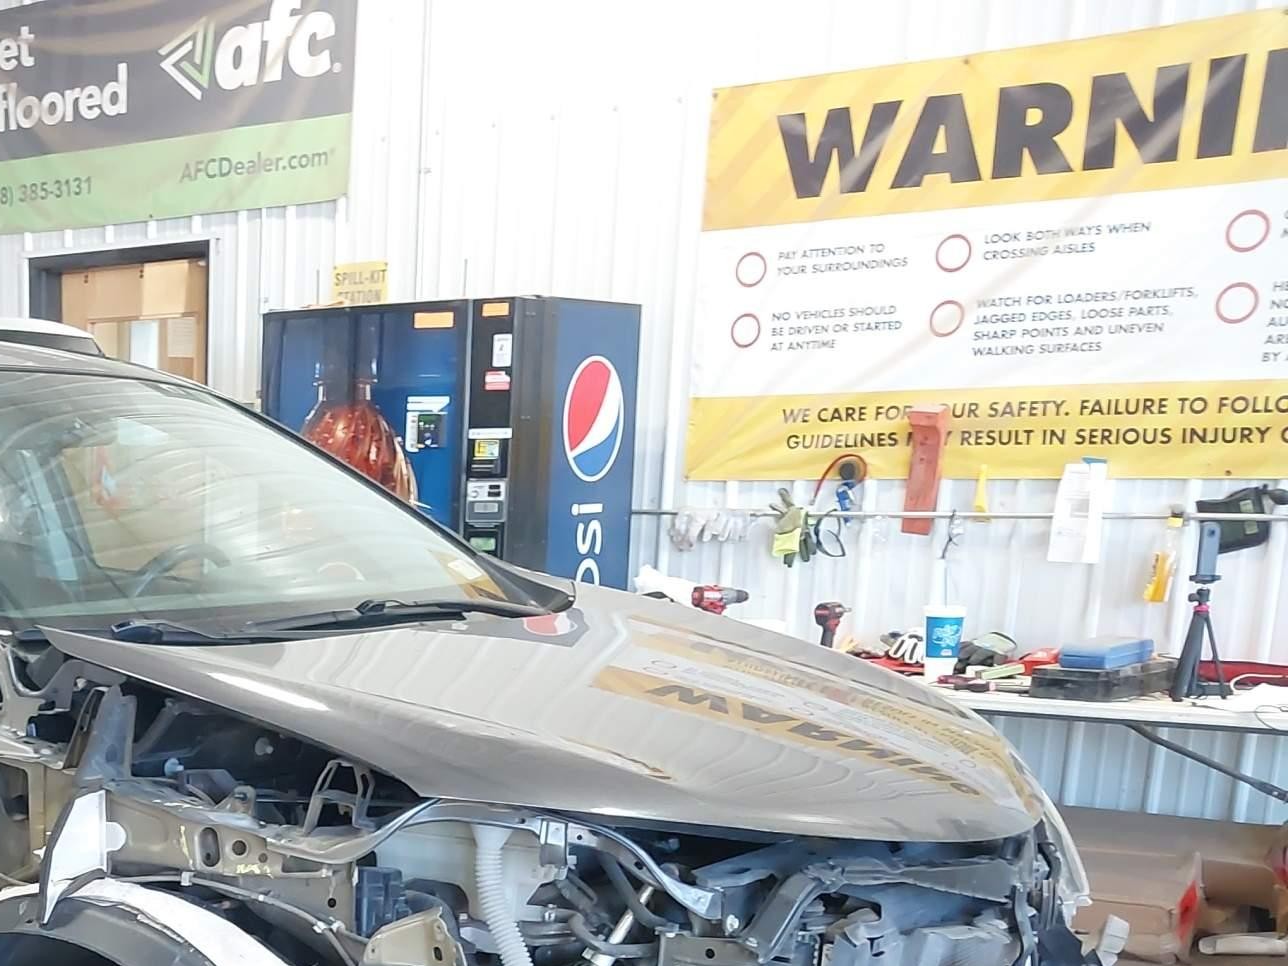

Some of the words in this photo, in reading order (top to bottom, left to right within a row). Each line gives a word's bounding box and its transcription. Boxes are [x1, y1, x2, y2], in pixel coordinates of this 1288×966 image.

[18, 176, 92, 203] 385-3131
[984, 232, 1020, 244] LOOK
[1026, 229, 1061, 242] BOTH
[1064, 225, 1102, 238] WAYS
[1108, 221, 1151, 234] WHEN
[778, 250, 798, 260] PAY
[801, 245, 865, 259] ATTENTION
[870, 243, 885, 253] TO
[983, 246, 1048, 261] CROSSING
[1053, 242, 1096, 255] AISLES
[777, 265, 808, 275] YOUR
[812, 256, 909, 273] SURROUNDINGS
[976, 296, 1022, 308] WATCH
[1026, 294, 1053, 305] FOR
[771, 312, 791, 321] NO
[795, 308, 845, 320] VEHICLES
[849, 305, 897, 317] SHOULD
[973, 312, 1026, 325] JAGGED
[1081, 307, 1124, 319] LOOSE
[771, 327, 784, 337] BE
[788, 325, 830, 336] DRIVEN
[832, 323, 849, 333] OR
[853, 320, 903, 332] STARTED
[973, 329, 1017, 341] SHARP
[1021, 326, 1069, 338] POINTS
[1074, 324, 1103, 336] AND
[1108, 322, 1165, 335] UNEVEN
[770, 342, 784, 351] AT
[787, 339, 837, 351] ANYTIME
[972, 344, 1035, 357] WALKING
[1039, 341, 1102, 354] SURFACES
[782, 408, 810, 424] WE
[817, 406, 867, 423] CARE
[987, 399, 1070, 419] SAFETY.
[1079, 398, 1168, 416] FAILURE
[1178, 396, 1208, 414] TO
[786, 431, 898, 449] GUIDELINES
[960, 429, 1035, 446] RESULT
[1042, 429, 1066, 445] IN
[1075, 427, 1172, 445] SERIOUS
[1181, 426, 1272, 444] INJURY
